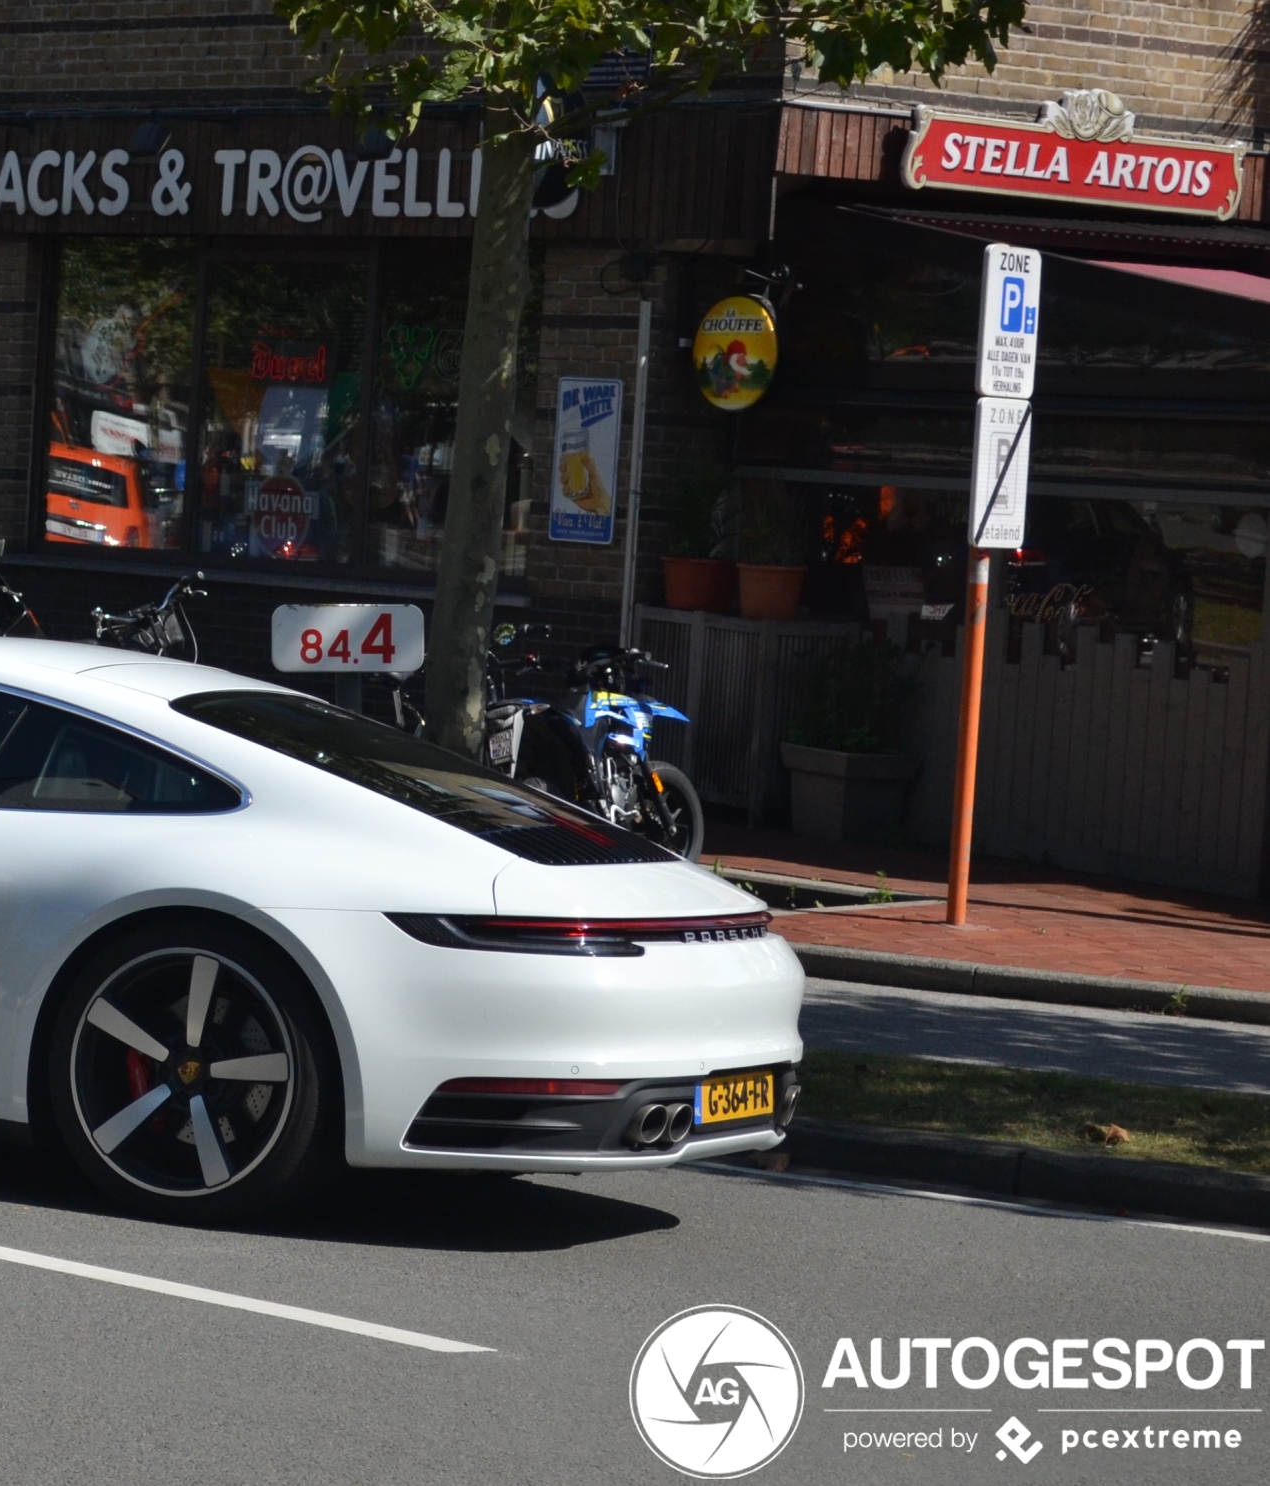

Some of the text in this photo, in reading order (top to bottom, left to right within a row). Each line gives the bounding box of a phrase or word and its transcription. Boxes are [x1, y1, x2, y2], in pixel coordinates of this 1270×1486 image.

[940, 132, 1213, 197] STELLA ARTOIS
[151, 148, 192, 216] &
[1000, 252, 1031, 274] ZONE
[726, 309, 735, 318] LA
[1002, 282, 1022, 326] P
[702, 319, 763, 332] CHOUFFE
[987, 350, 1031, 364] ALLE DAGEN VAN
[1003, 366, 1013, 378] TOT
[993, 380, 1022, 393] HERHALING
[562, 385, 616, 412] DE WARE
[579, 398, 612, 420] WITTE
[990, 408, 1024, 425] ZONE
[247, 486, 314, 515] Havana
[260, 514, 298, 540] Club
[981, 523, 1020, 540] etalend
[299, 613, 396, 665] 84.4
[684, 926, 767, 943] PORSCHE
[708, 1077, 770, 1117] G-364-FR
